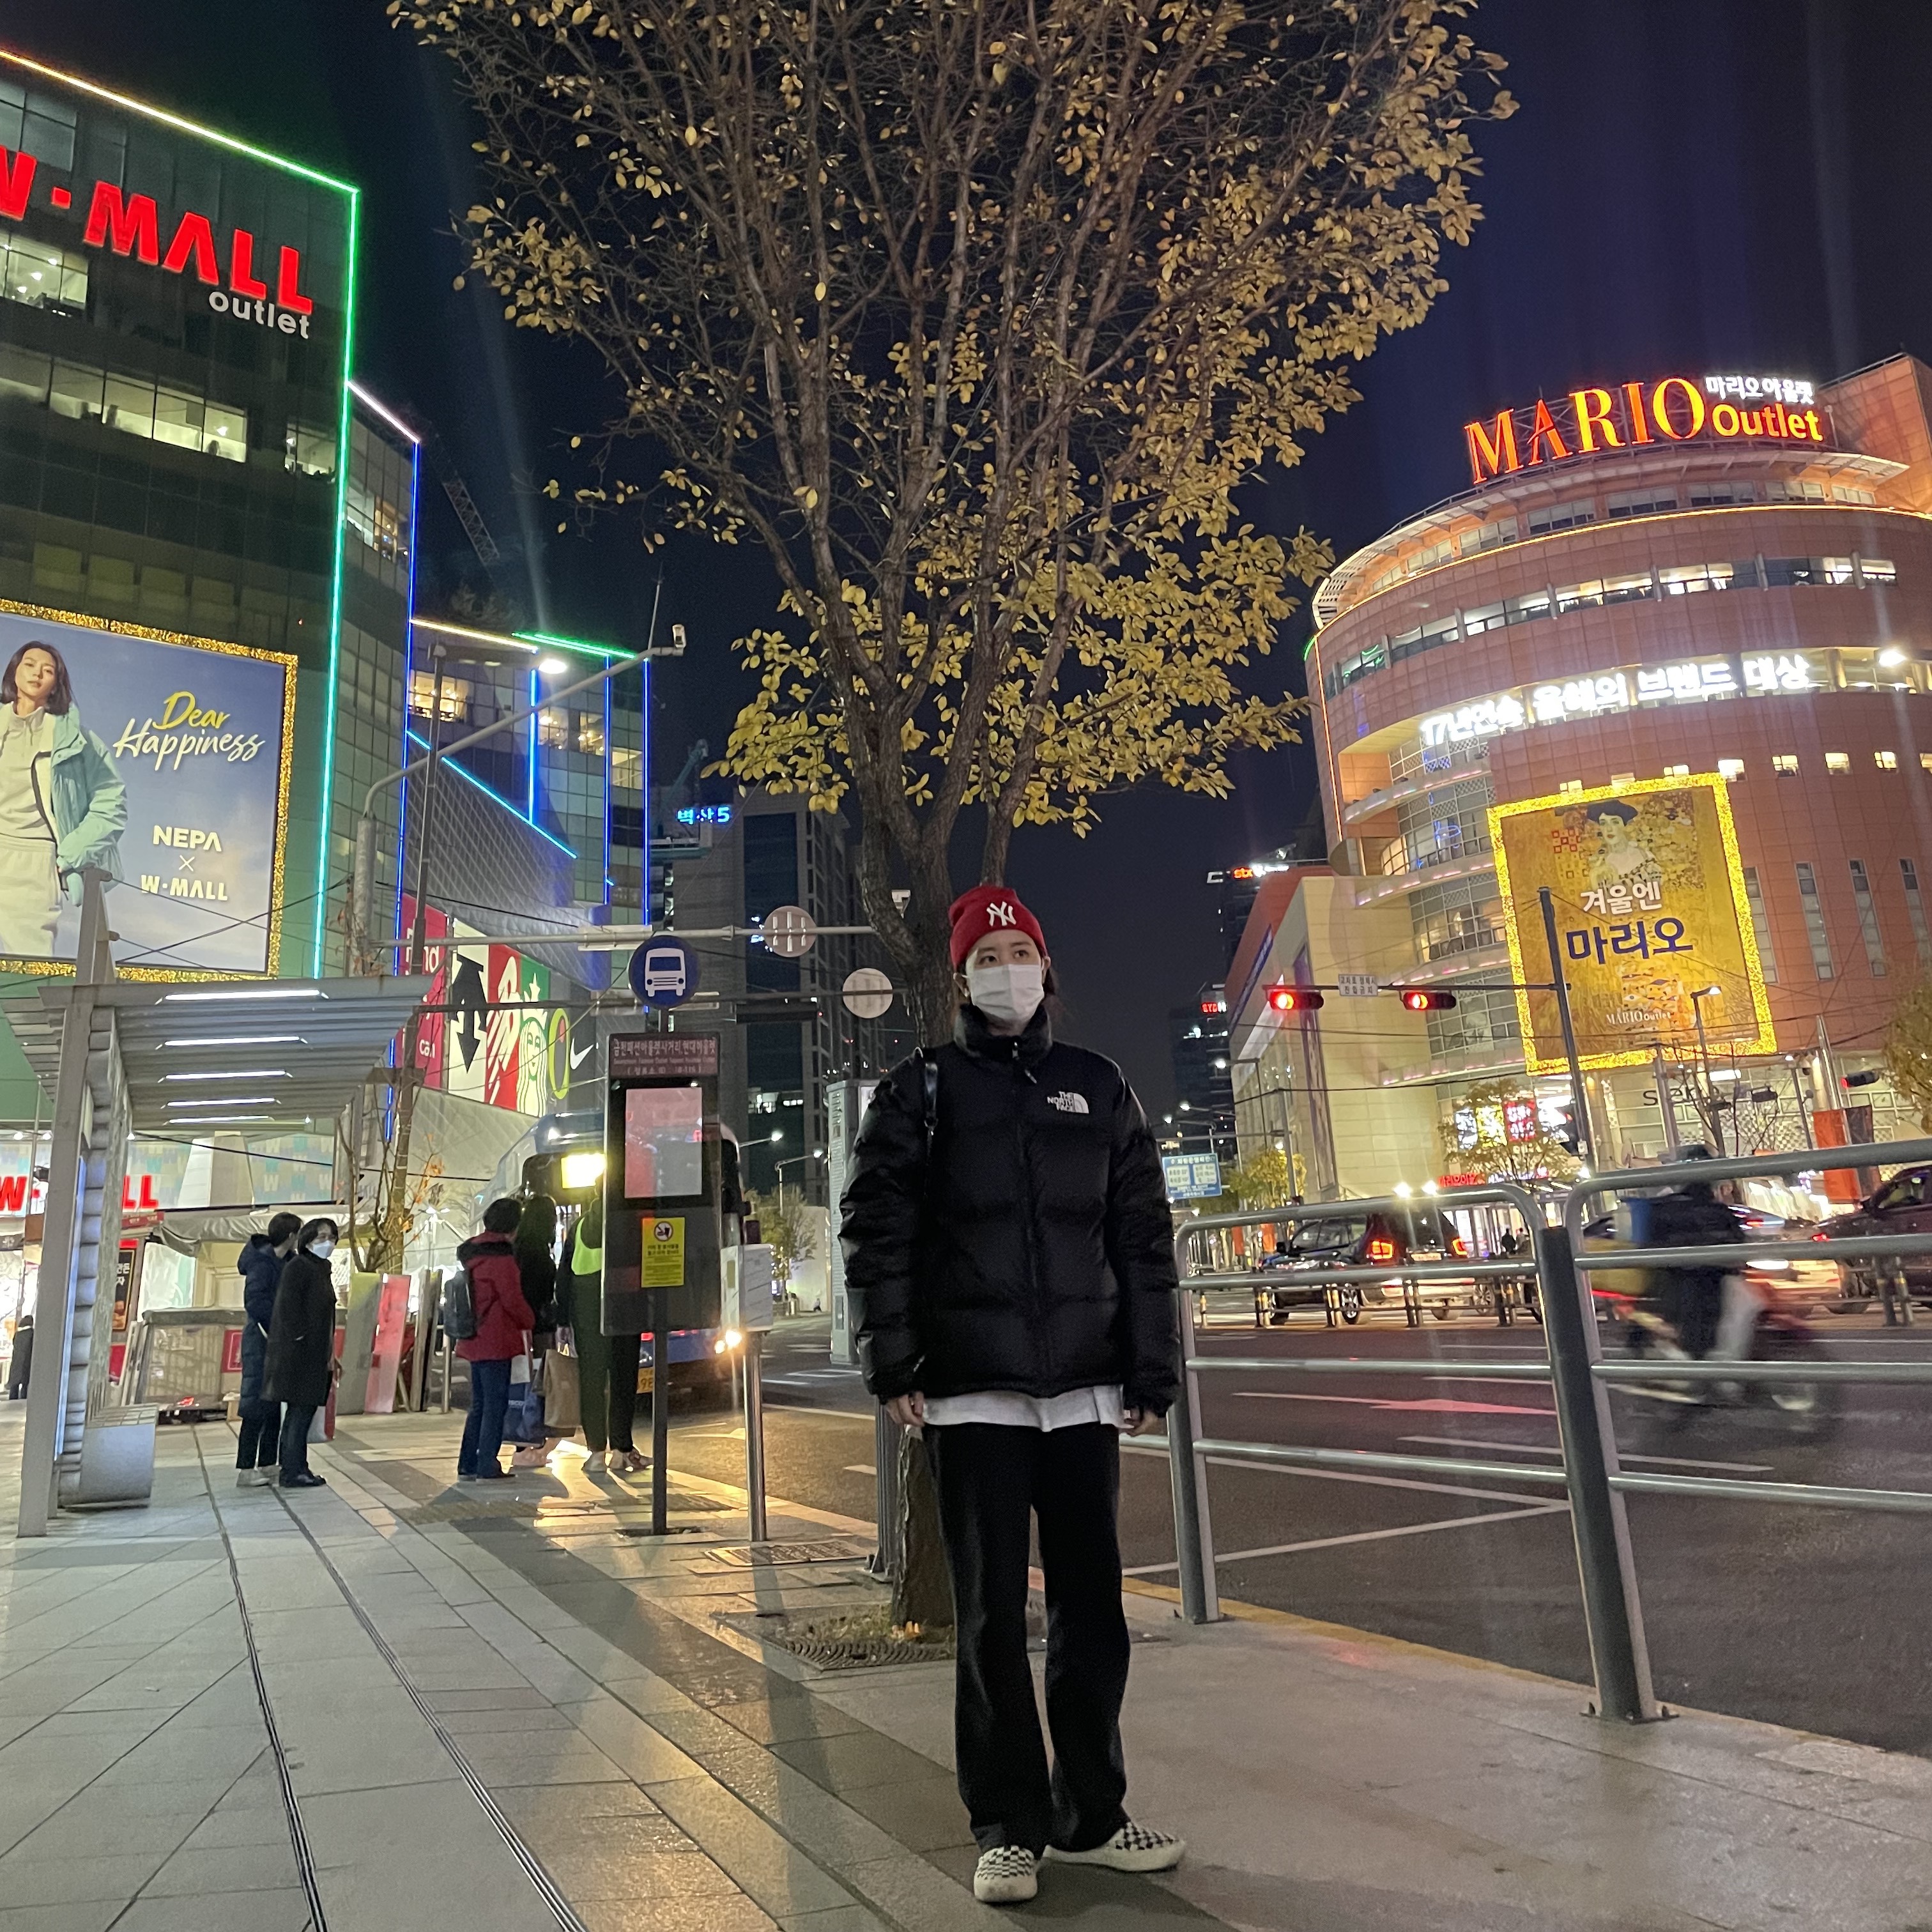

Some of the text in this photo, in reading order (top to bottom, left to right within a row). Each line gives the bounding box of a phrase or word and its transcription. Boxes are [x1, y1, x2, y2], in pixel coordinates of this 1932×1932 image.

[209, 291, 310, 339] outlet
[1705, 376, 1814, 405] 마리오아울렛
[1464, 378, 1824, 484] MARIO Outlet
[1637, 663, 1738, 701] 브랜드
[1743, 654, 1810, 691] 대상
[153, 691, 231, 731] Dear
[113, 718, 266, 771] Happiness
[153, 825, 222, 852] NEPA
[986, 901, 1017, 926] NY
[1580, 881, 1662, 916] 겨울엔
[1565, 917, 1694, 965] 마리오
[1606, 1011, 1643, 1025] MARIO
